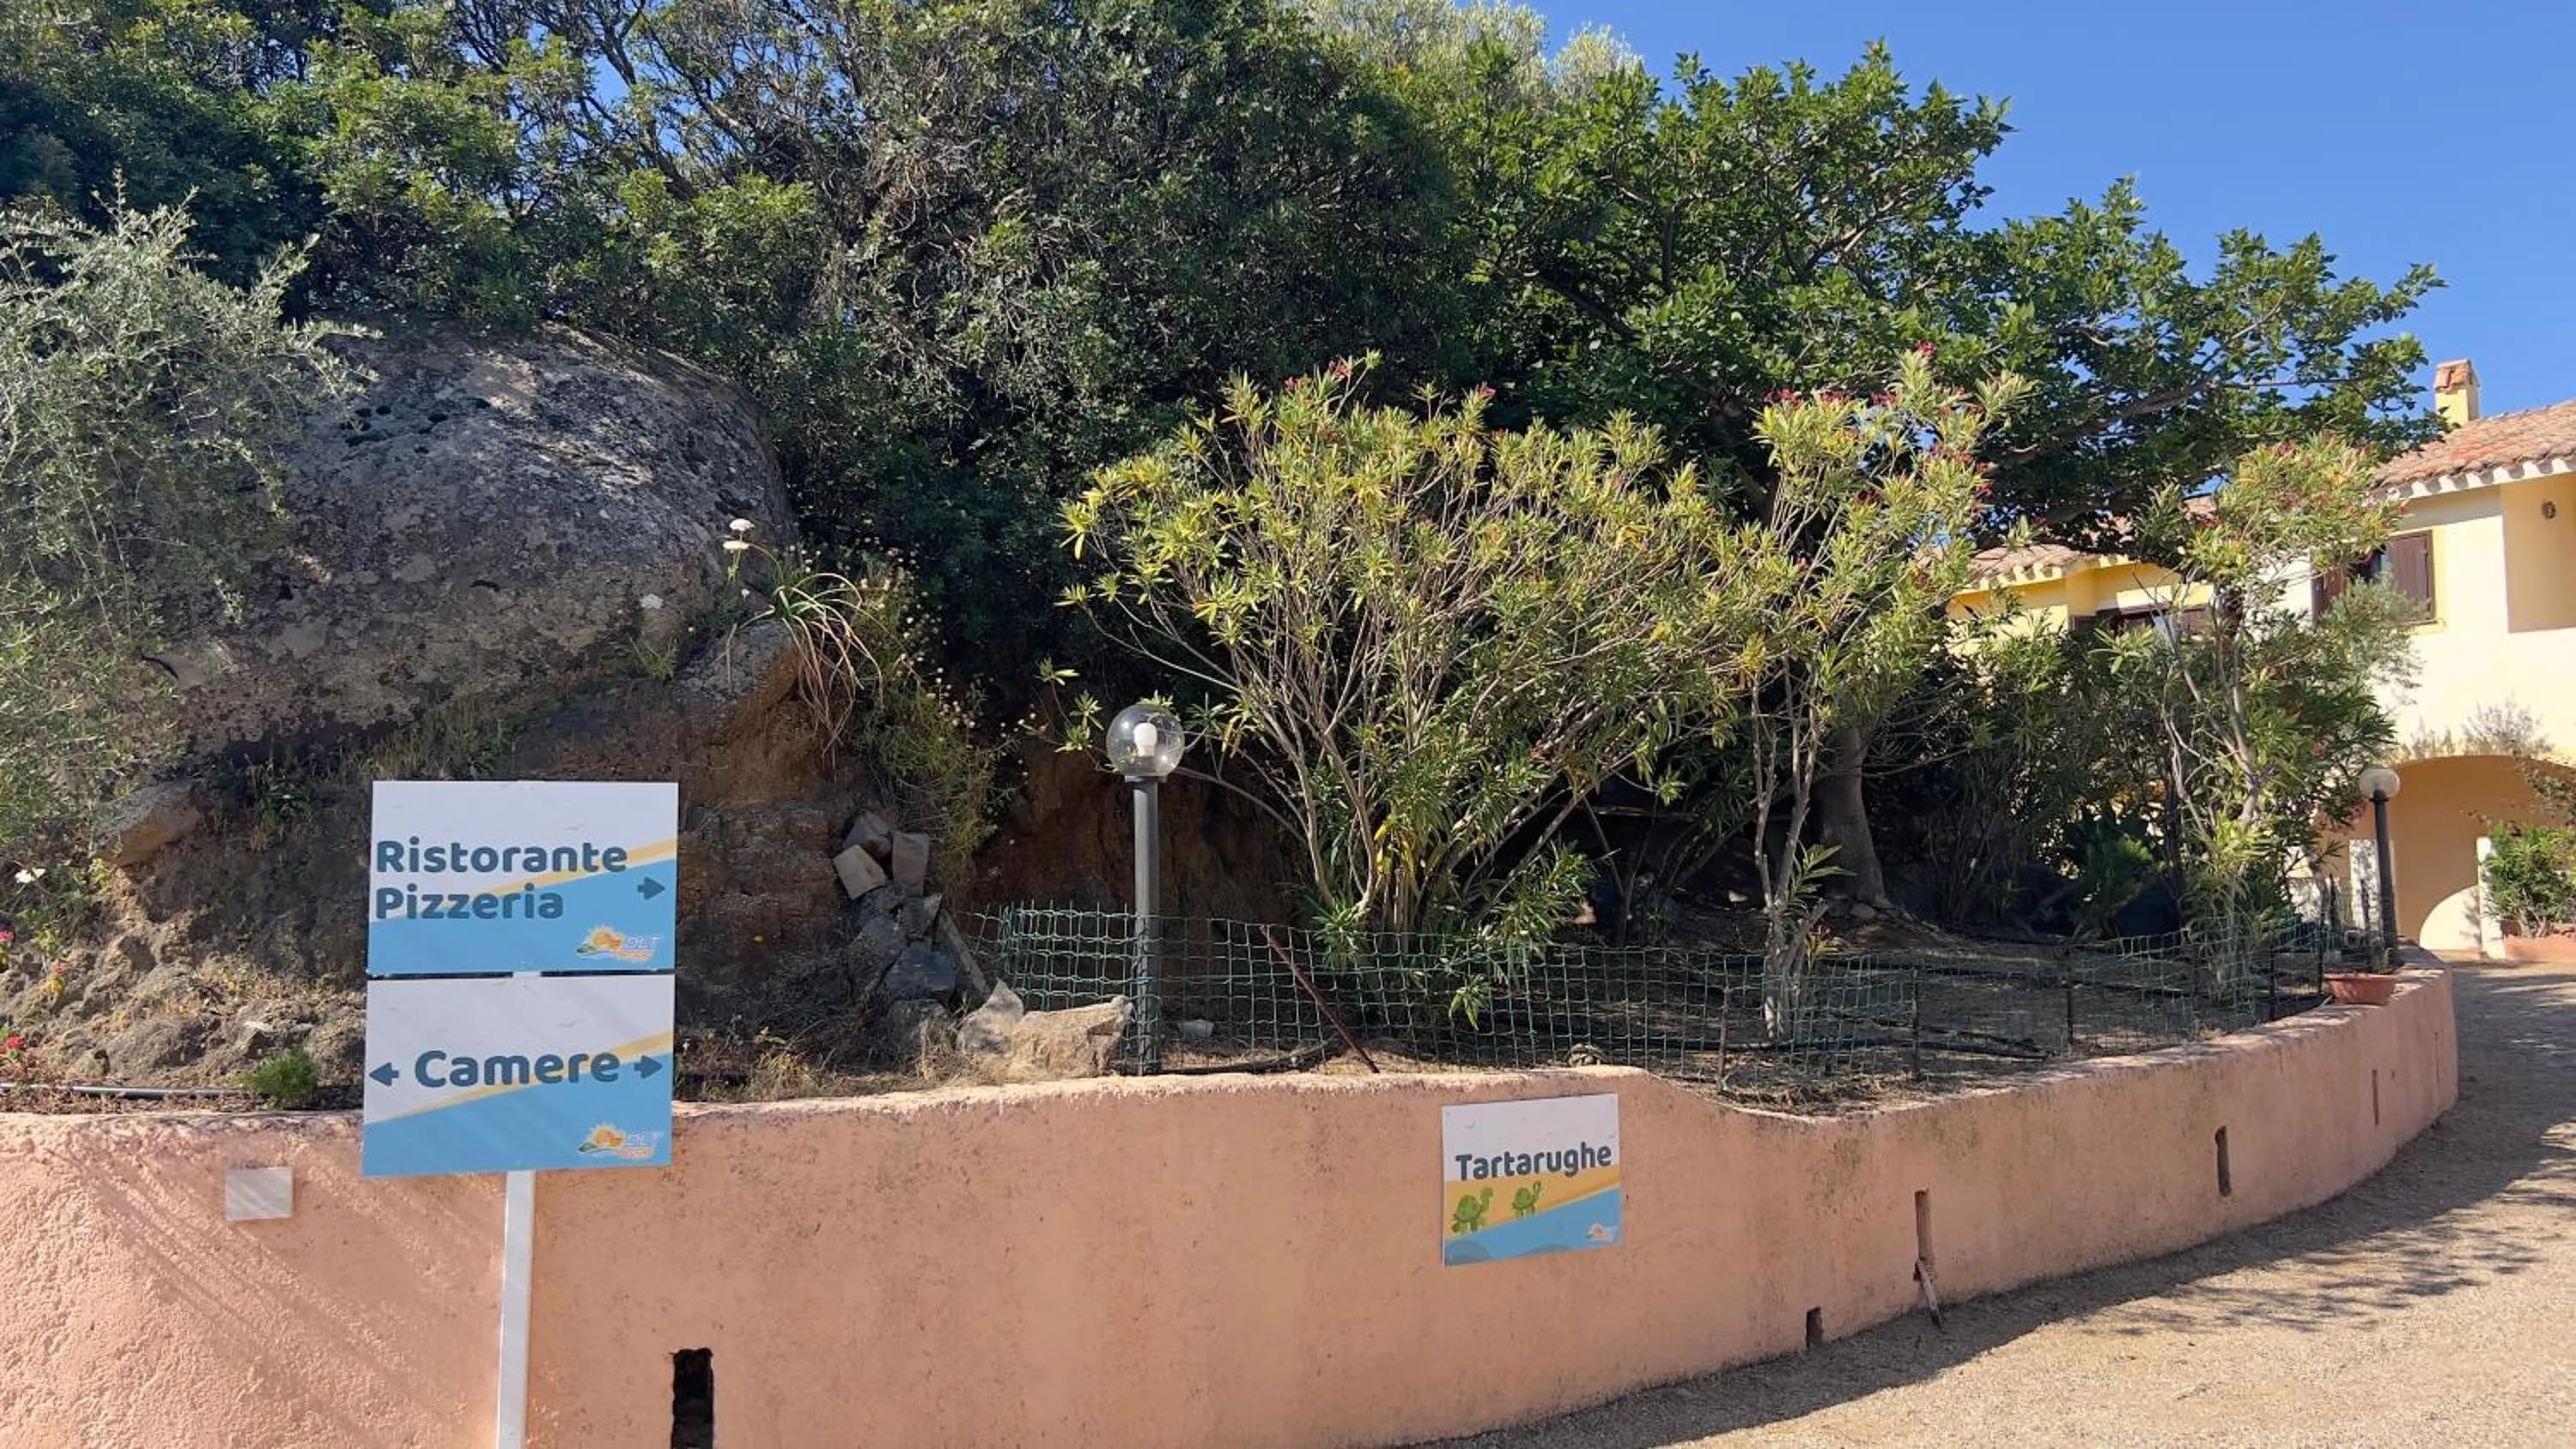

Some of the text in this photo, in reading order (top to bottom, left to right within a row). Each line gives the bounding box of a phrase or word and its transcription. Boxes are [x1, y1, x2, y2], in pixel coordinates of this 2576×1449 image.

[376, 836, 628, 873] Ristorante
[375, 883, 564, 920] Pizzeria
[414, 1050, 621, 1088] Camere
[1455, 1141, 1612, 1181] Tartarughe
